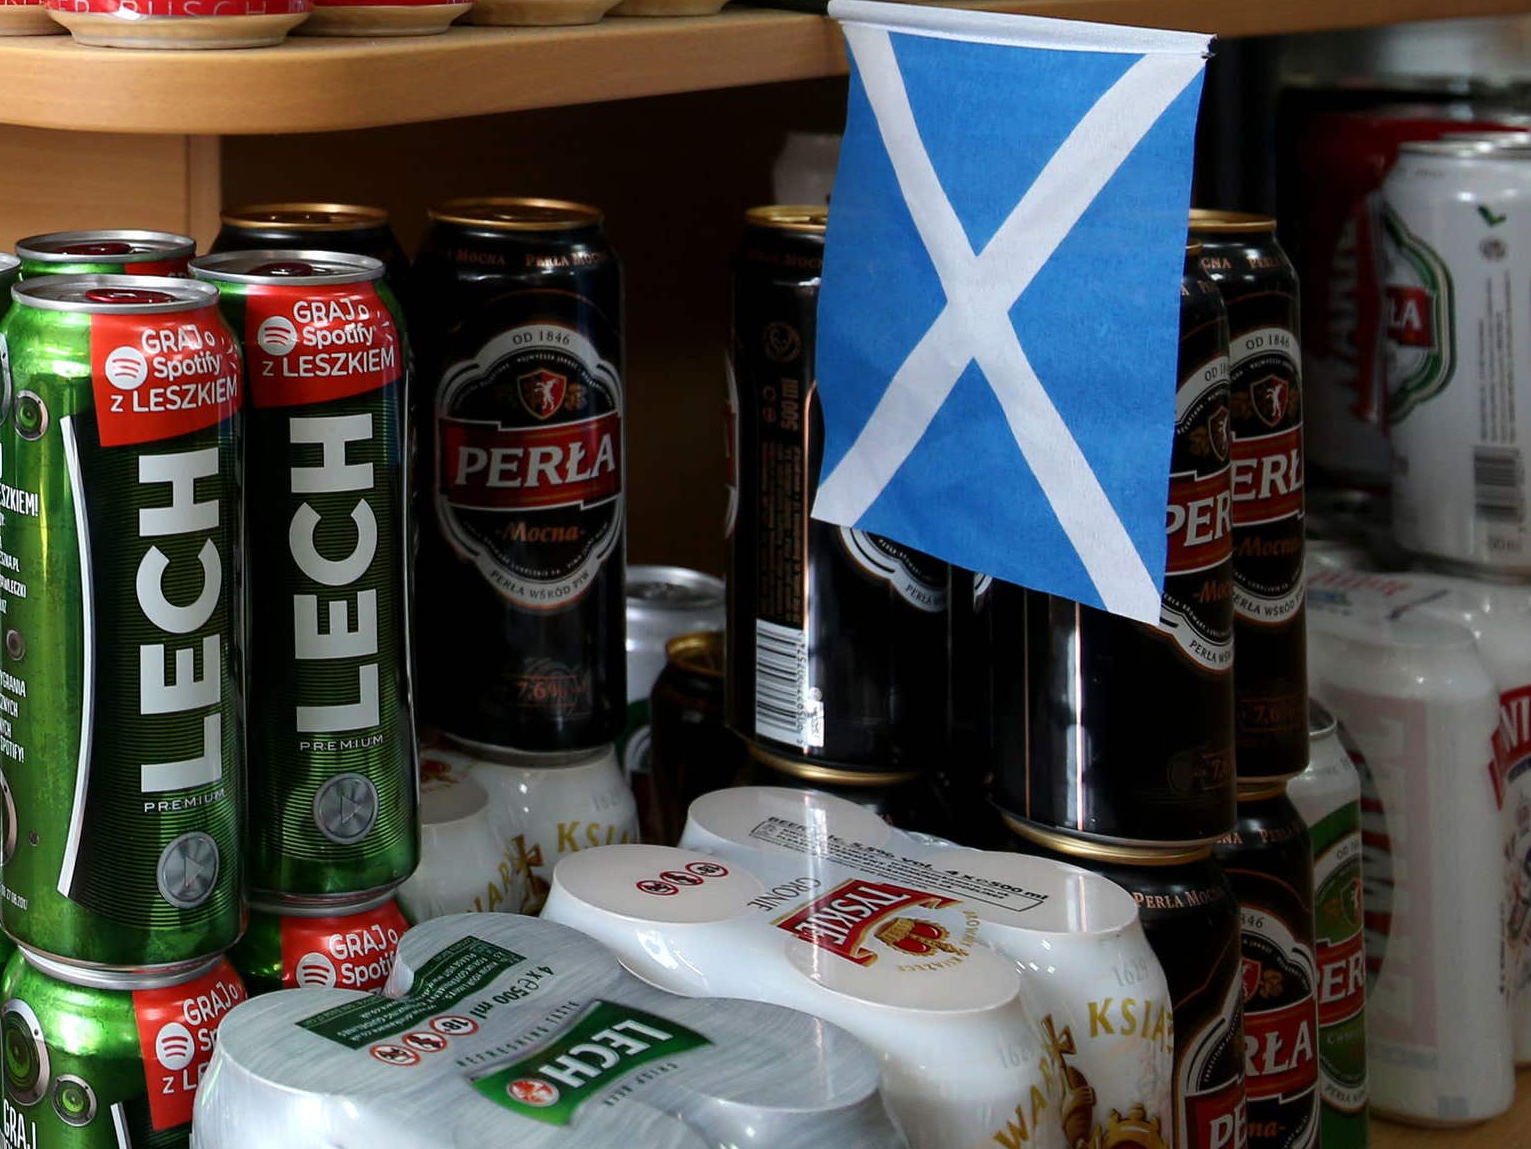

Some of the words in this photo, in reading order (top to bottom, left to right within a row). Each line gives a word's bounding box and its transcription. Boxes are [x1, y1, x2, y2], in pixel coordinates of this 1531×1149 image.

[292, 298, 356, 325] GRAJ
[140, 324, 204, 356] GRAJ
[302, 323, 374, 350] Spotify
[512, 332, 534, 346] OD
[538, 331, 571, 345] 1846
[1245, 338, 1265, 351] OD
[1266, 335, 1293, 350] 1846
[153, 352, 220, 382] Spotify
[282, 345, 396, 378] LESZKIEM
[1204, 366, 1220, 383] OD
[131, 376, 238, 413] LESZKIEM
[456, 434, 617, 489] PERŁA
[1232, 447, 1303, 504] ERŁ
[500, 520, 581, 542] Mocna
[288, 412, 381, 734] LECH
[488, 568, 527, 598] PERŁA
[571, 569, 592, 593] PIW
[136, 447, 223, 794] LECH
[299, 734, 385, 753] PREMIUM
[143, 788, 226, 813] PREMIUM
[794, 885, 912, 946] TYSKIE
[328, 923, 385, 961] GRAJ
[182, 981, 228, 1026] GRAJ
[538, 1019, 674, 1089] LECH
